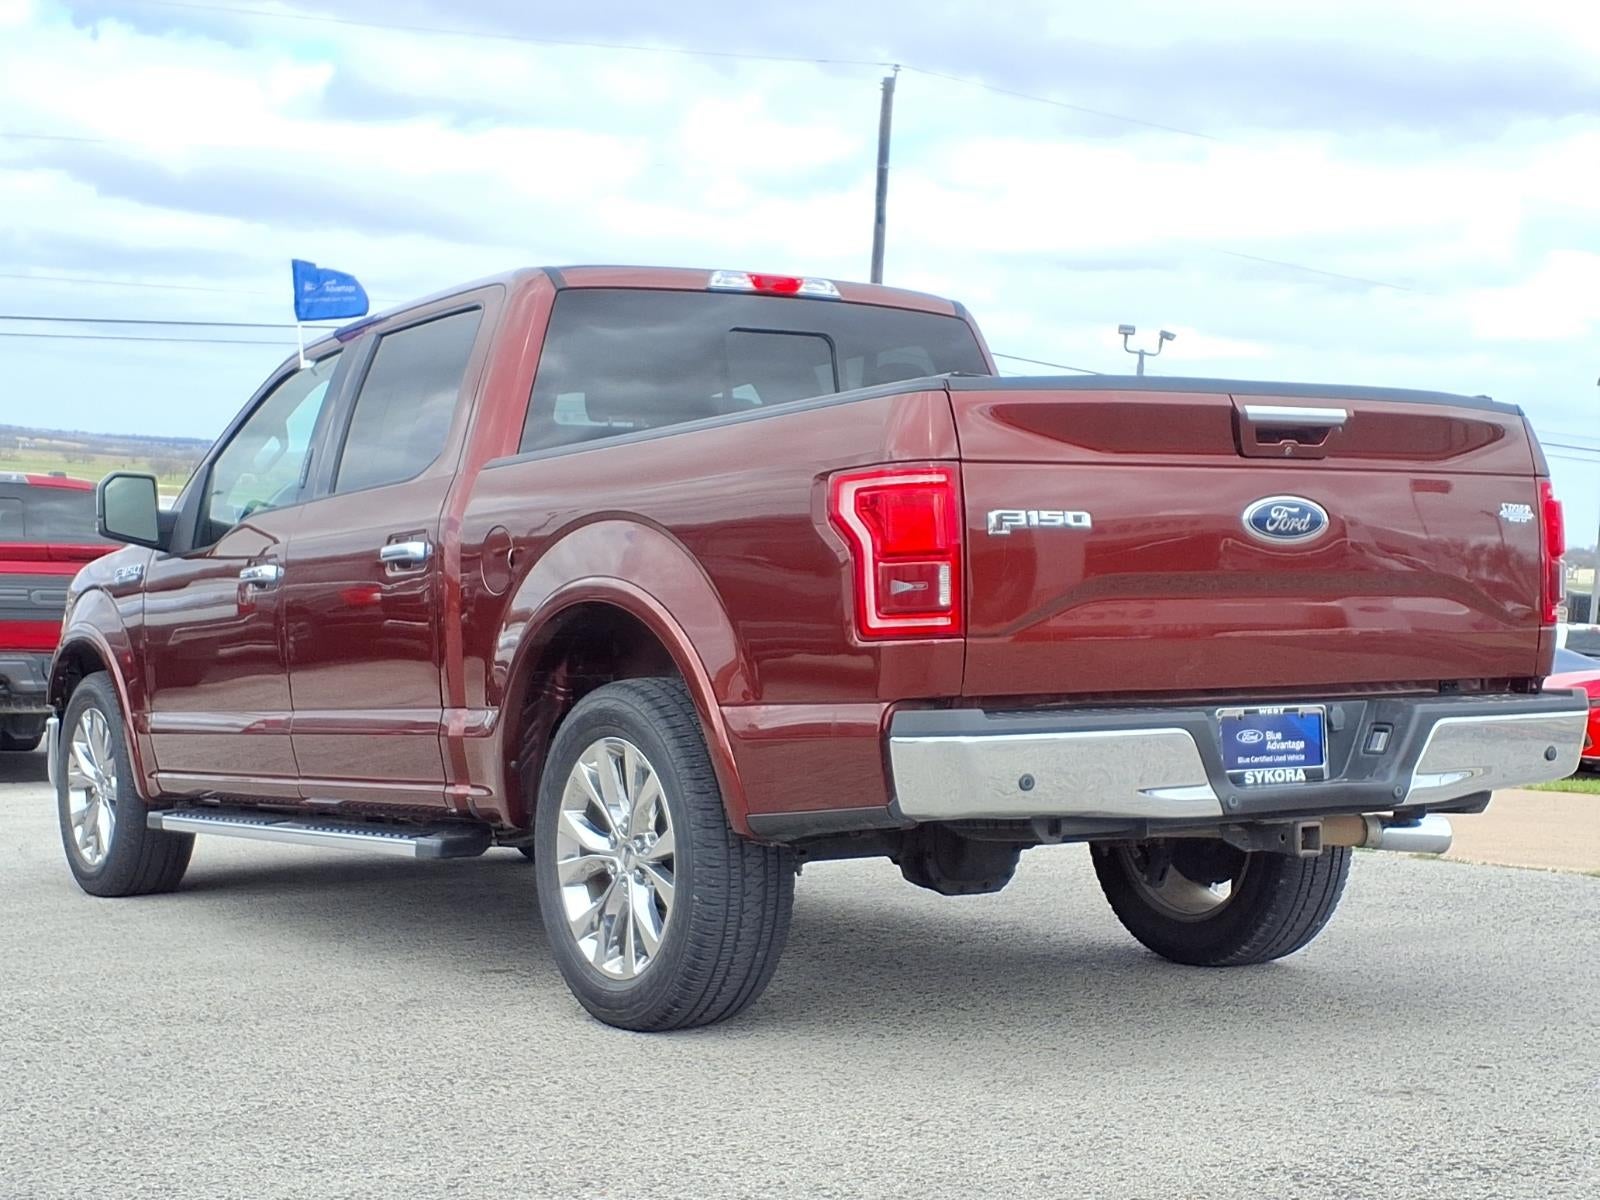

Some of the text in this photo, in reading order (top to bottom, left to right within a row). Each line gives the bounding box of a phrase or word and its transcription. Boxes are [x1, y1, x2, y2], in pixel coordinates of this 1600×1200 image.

[1266, 505, 1311, 532] Ford
[1265, 731, 1282, 740] Blue
[1266, 740, 1305, 750] Advantage
[1244, 769, 1306, 784] SYKORA
